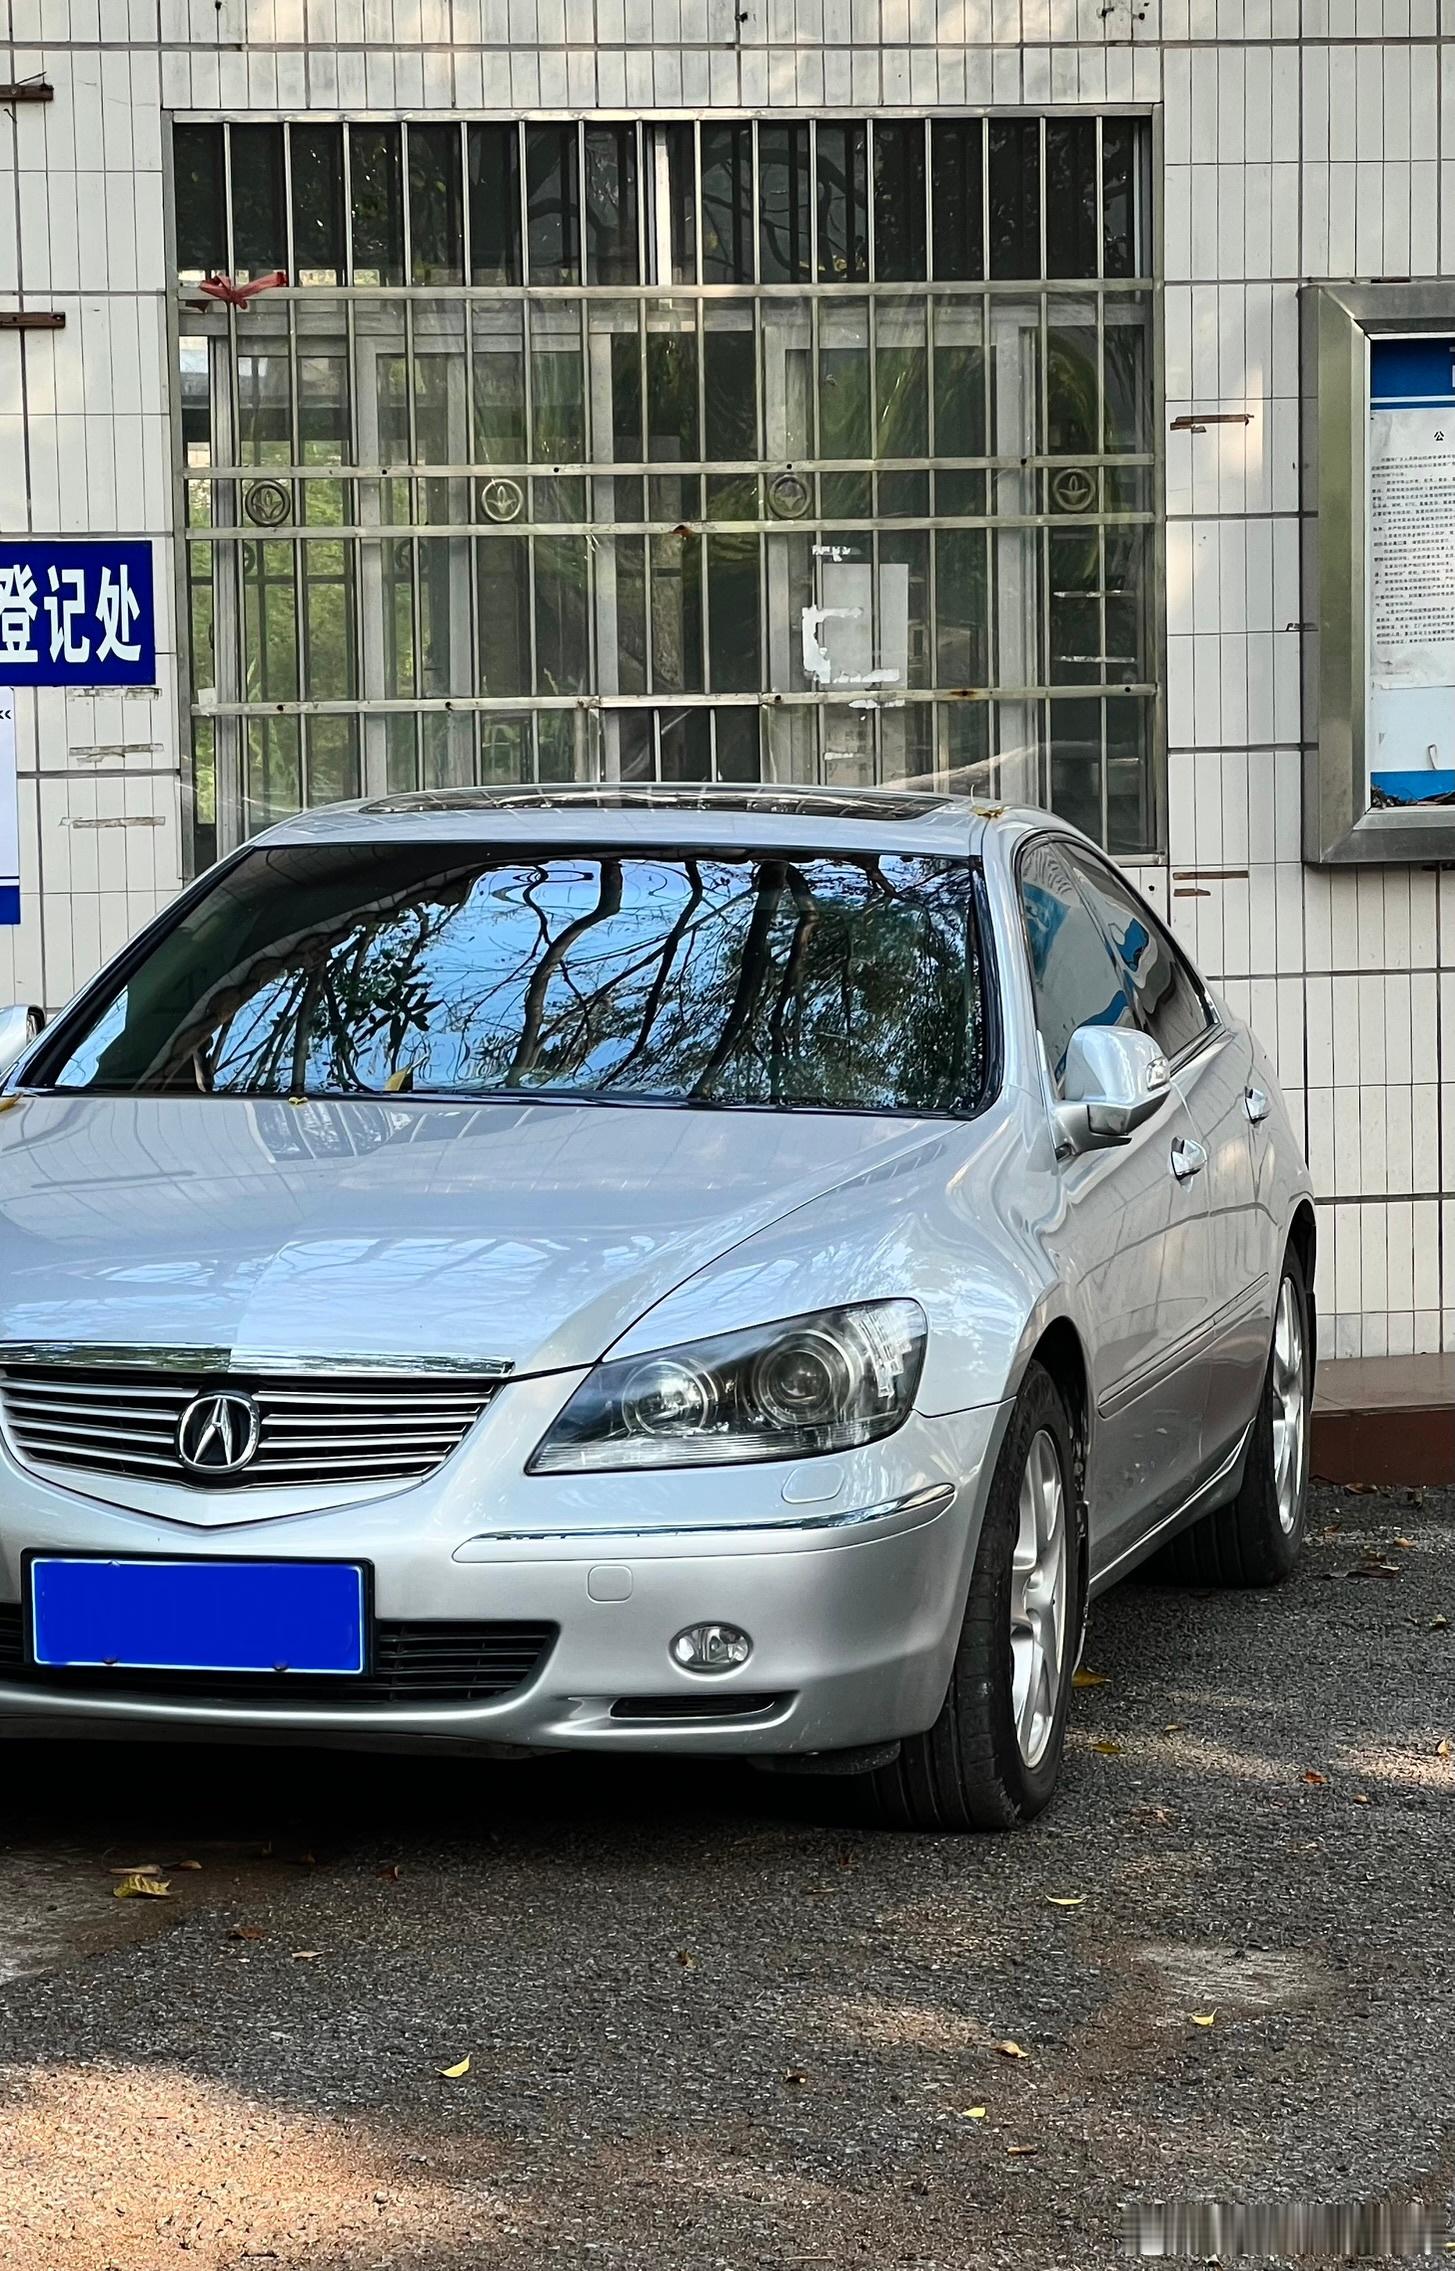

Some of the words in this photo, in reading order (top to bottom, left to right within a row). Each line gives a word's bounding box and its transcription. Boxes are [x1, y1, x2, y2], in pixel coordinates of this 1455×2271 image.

[1433, 430, 1445, 442] 公
[0, 564, 142, 663] 登记处
